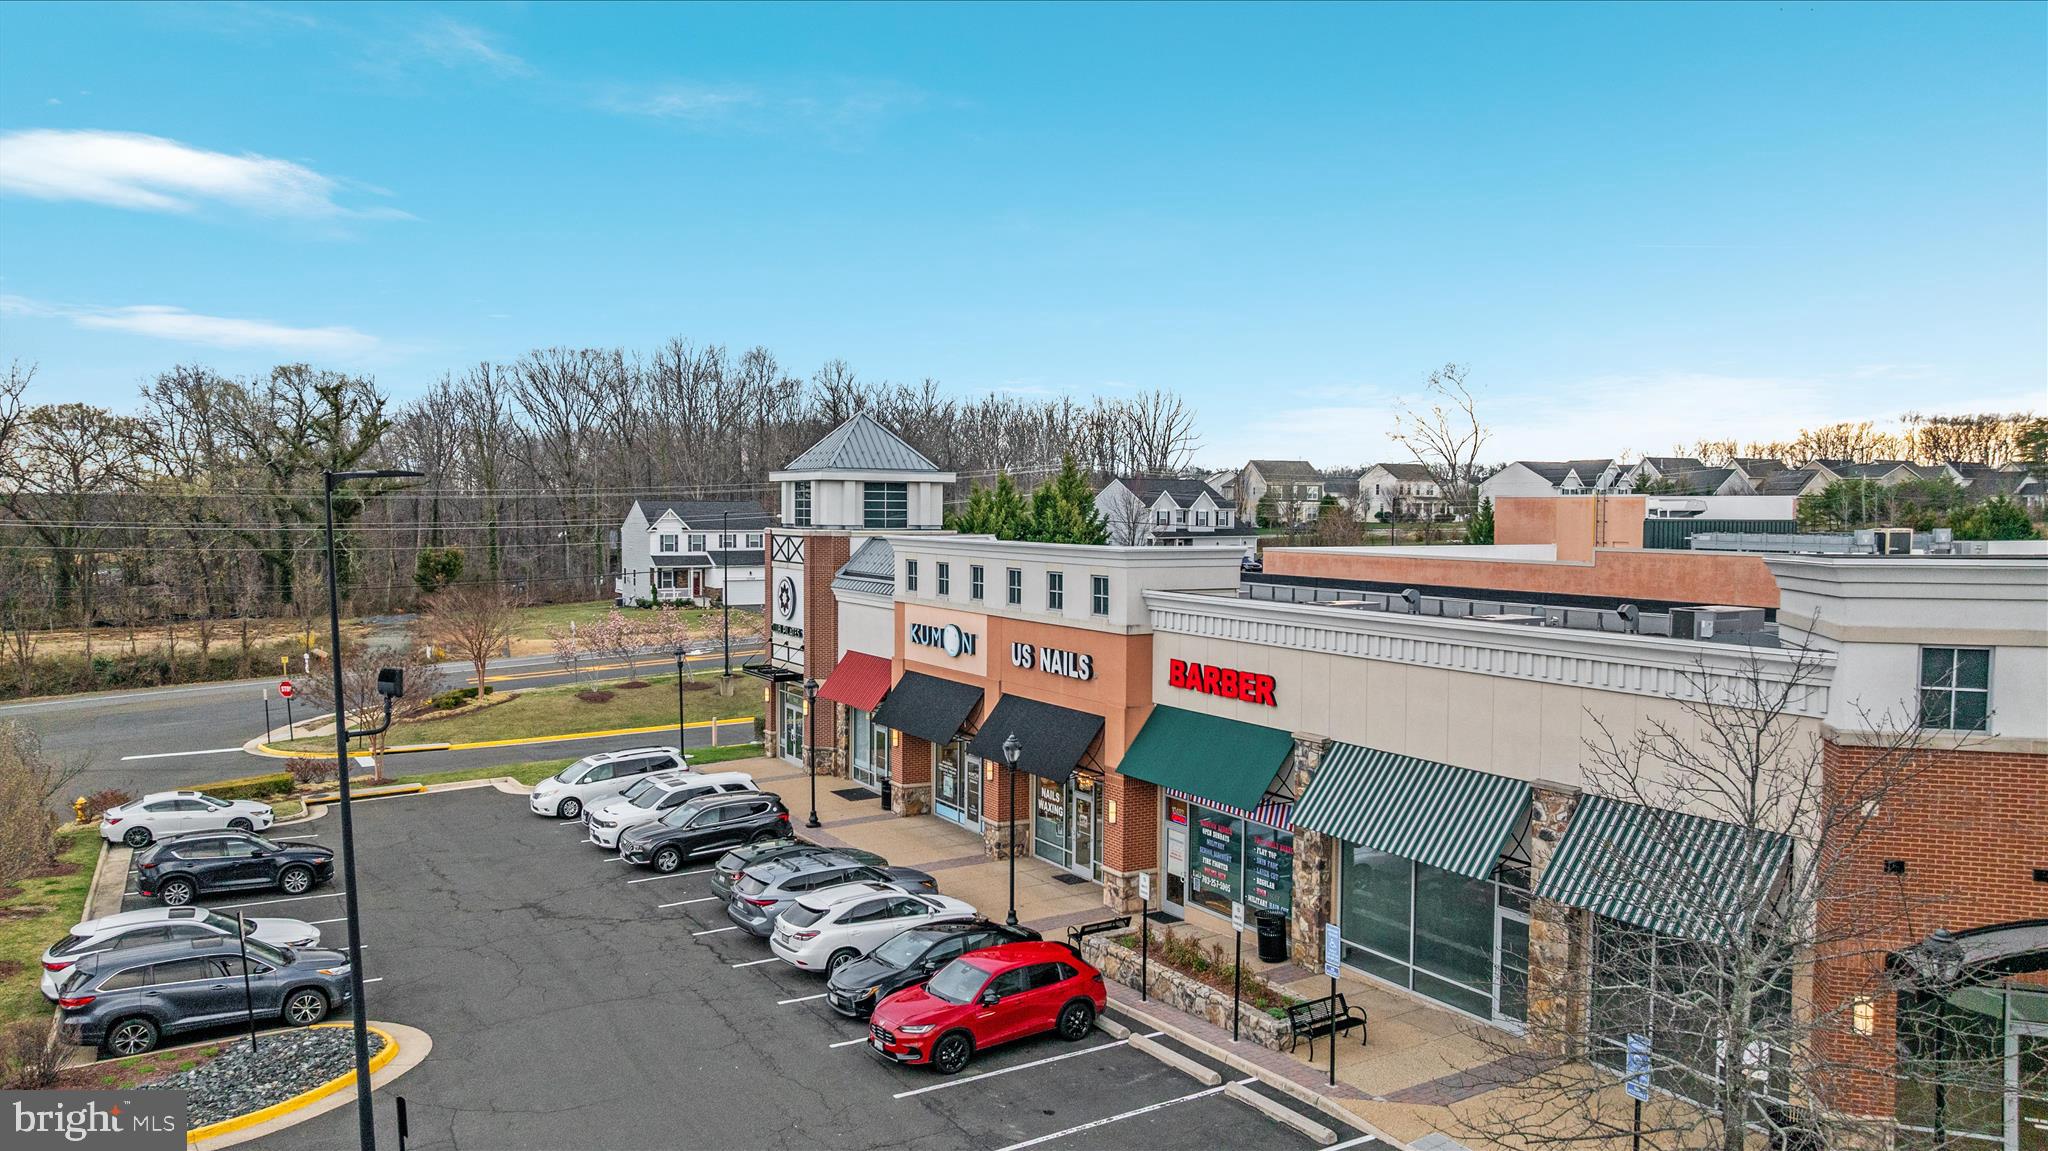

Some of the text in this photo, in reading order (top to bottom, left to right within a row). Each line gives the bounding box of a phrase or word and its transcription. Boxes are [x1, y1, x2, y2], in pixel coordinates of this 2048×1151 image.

[910, 623, 976, 657] KUMON
[1011, 642, 1094, 681] US NAILS
[1169, 658, 1277, 707] BARBER
[1041, 787, 1060, 802] NAILS
[1038, 799, 1063, 817] WAXING
[1267, 851, 1277, 860] TOP
